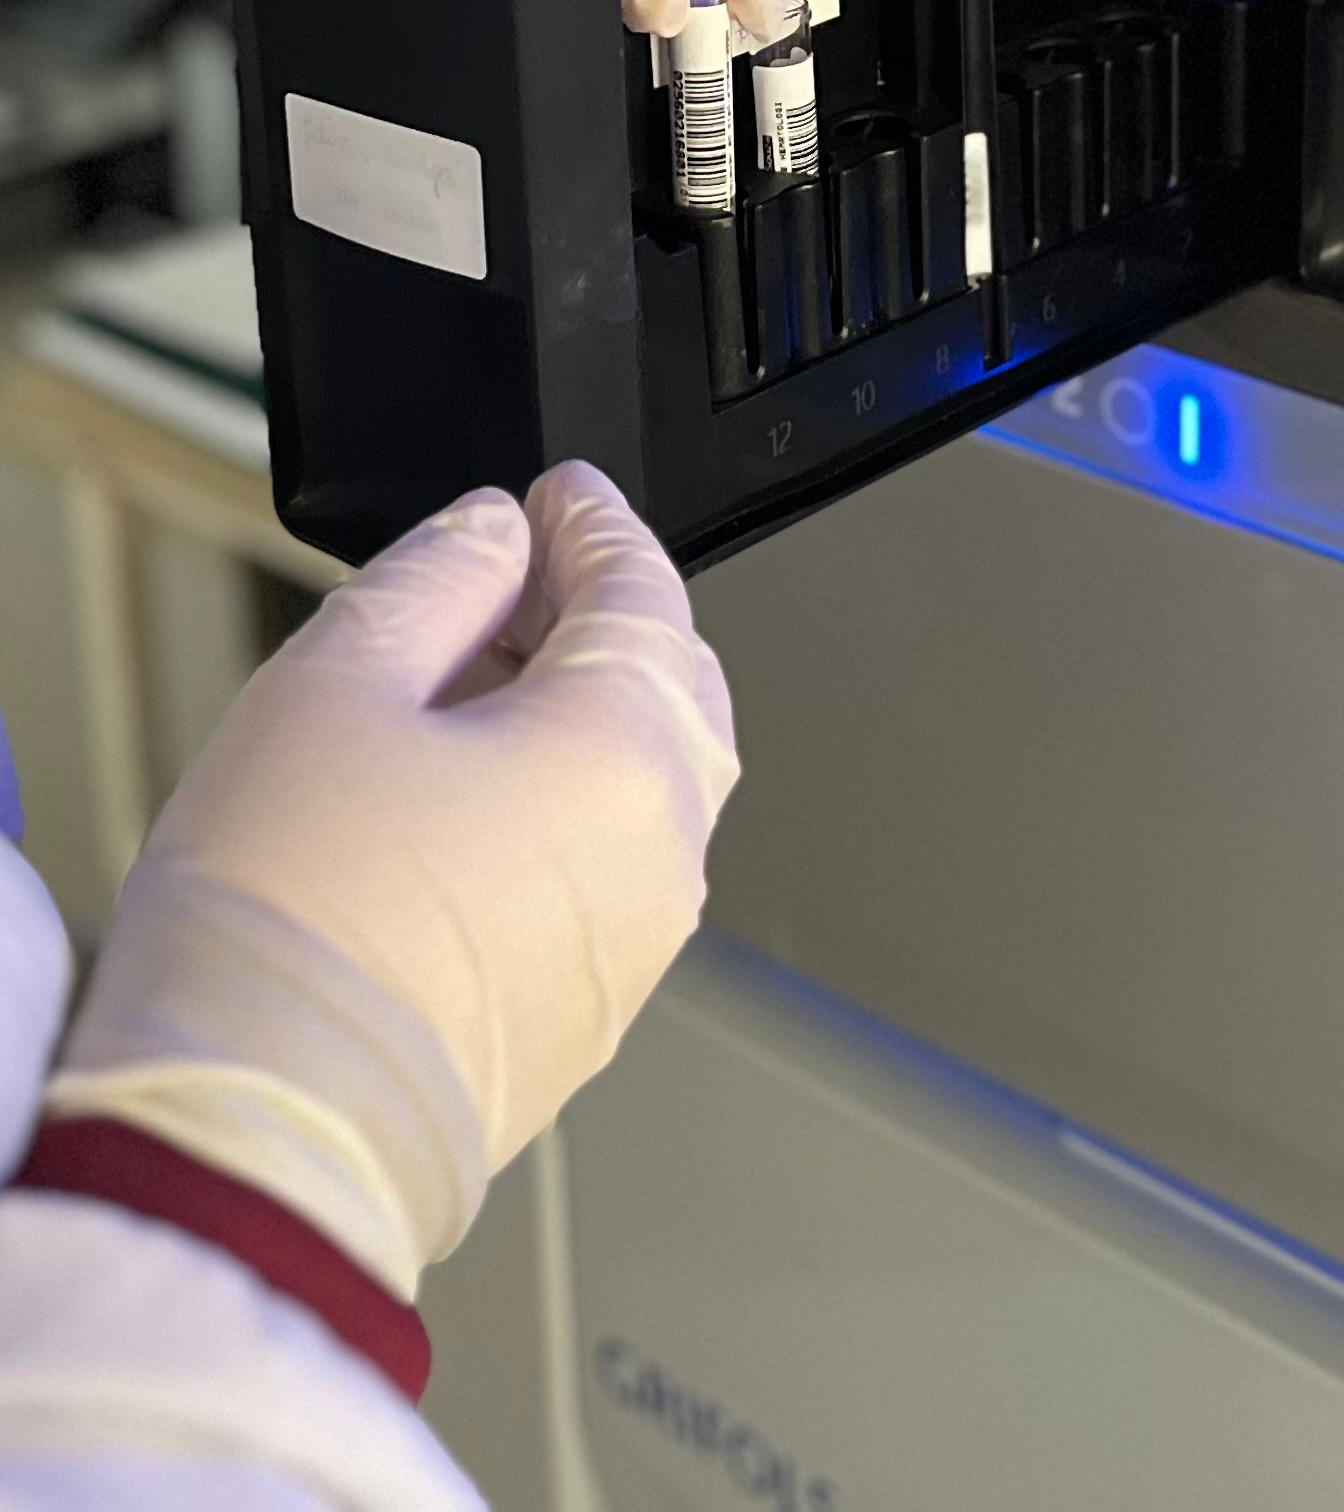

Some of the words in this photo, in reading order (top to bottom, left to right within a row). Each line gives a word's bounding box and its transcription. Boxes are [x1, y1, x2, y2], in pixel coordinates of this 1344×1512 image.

[766, 419, 793, 458] 12
[850, 378, 877, 416] 10
[1042, 294, 1056, 322] 6
